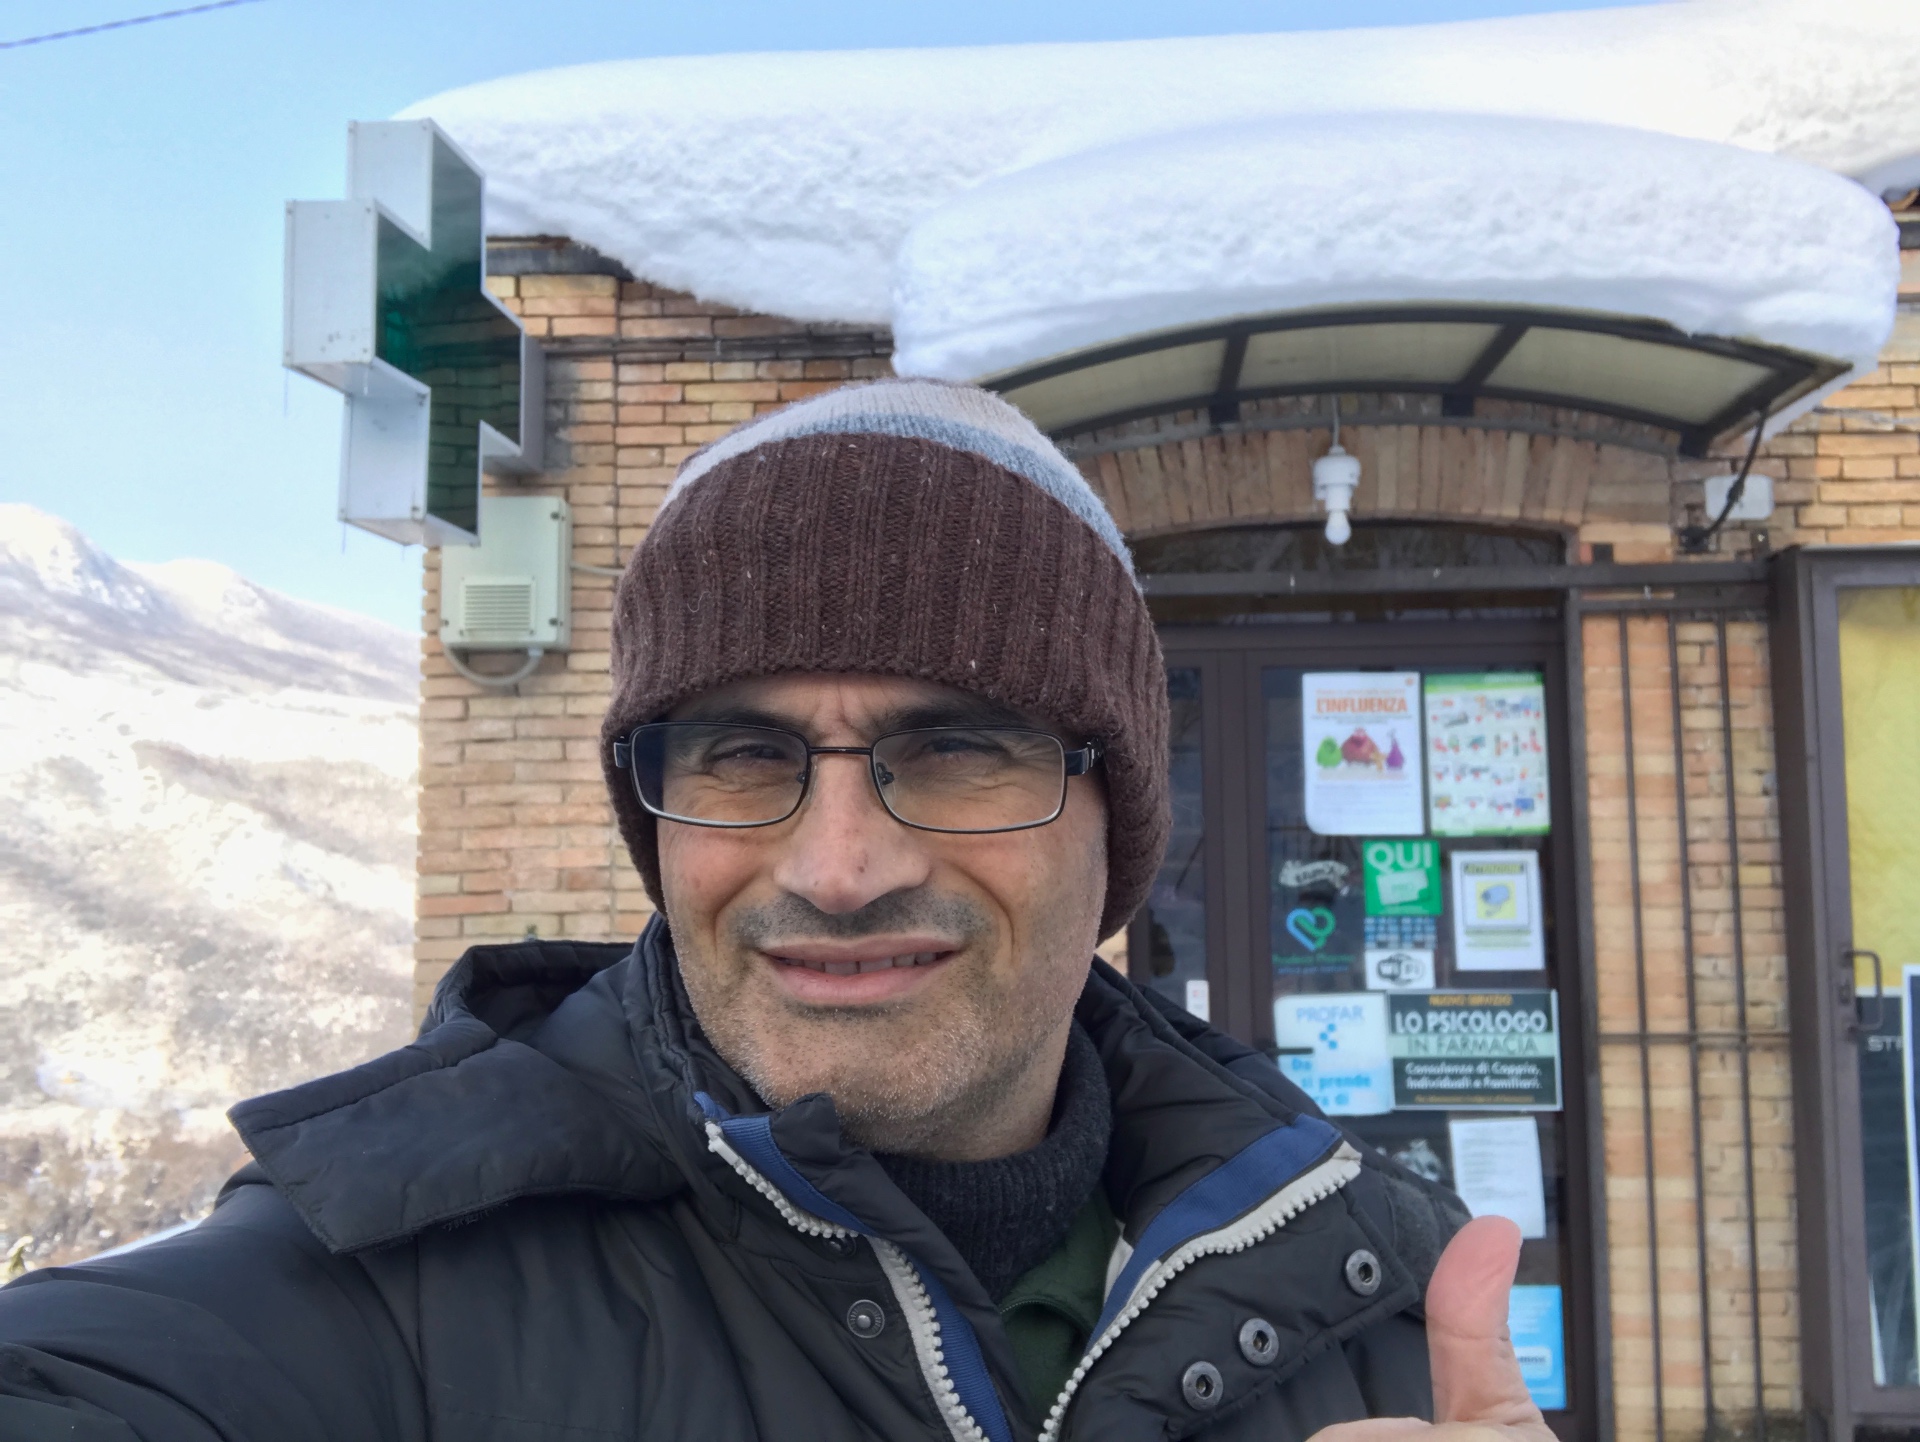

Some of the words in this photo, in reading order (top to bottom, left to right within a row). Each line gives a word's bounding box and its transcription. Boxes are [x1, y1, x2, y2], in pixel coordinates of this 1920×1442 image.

[1316, 697, 1408, 713] L'INFLUENZA
[1366, 842, 1433, 874] QUI
[1395, 1010, 1424, 1034] LO
[1427, 1010, 1548, 1034] PSICOLOGO
[1408, 1036, 1428, 1055] IN
[1437, 1034, 1539, 1055] FARMACIA
[1405, 1061, 1475, 1075] Consulenza
[1477, 1061, 1490, 1075] di
[1319, 1074, 1372, 1091] prende
[1406, 1076, 1472, 1089] Individuali
[1473, 1080, 1482, 1089] e
